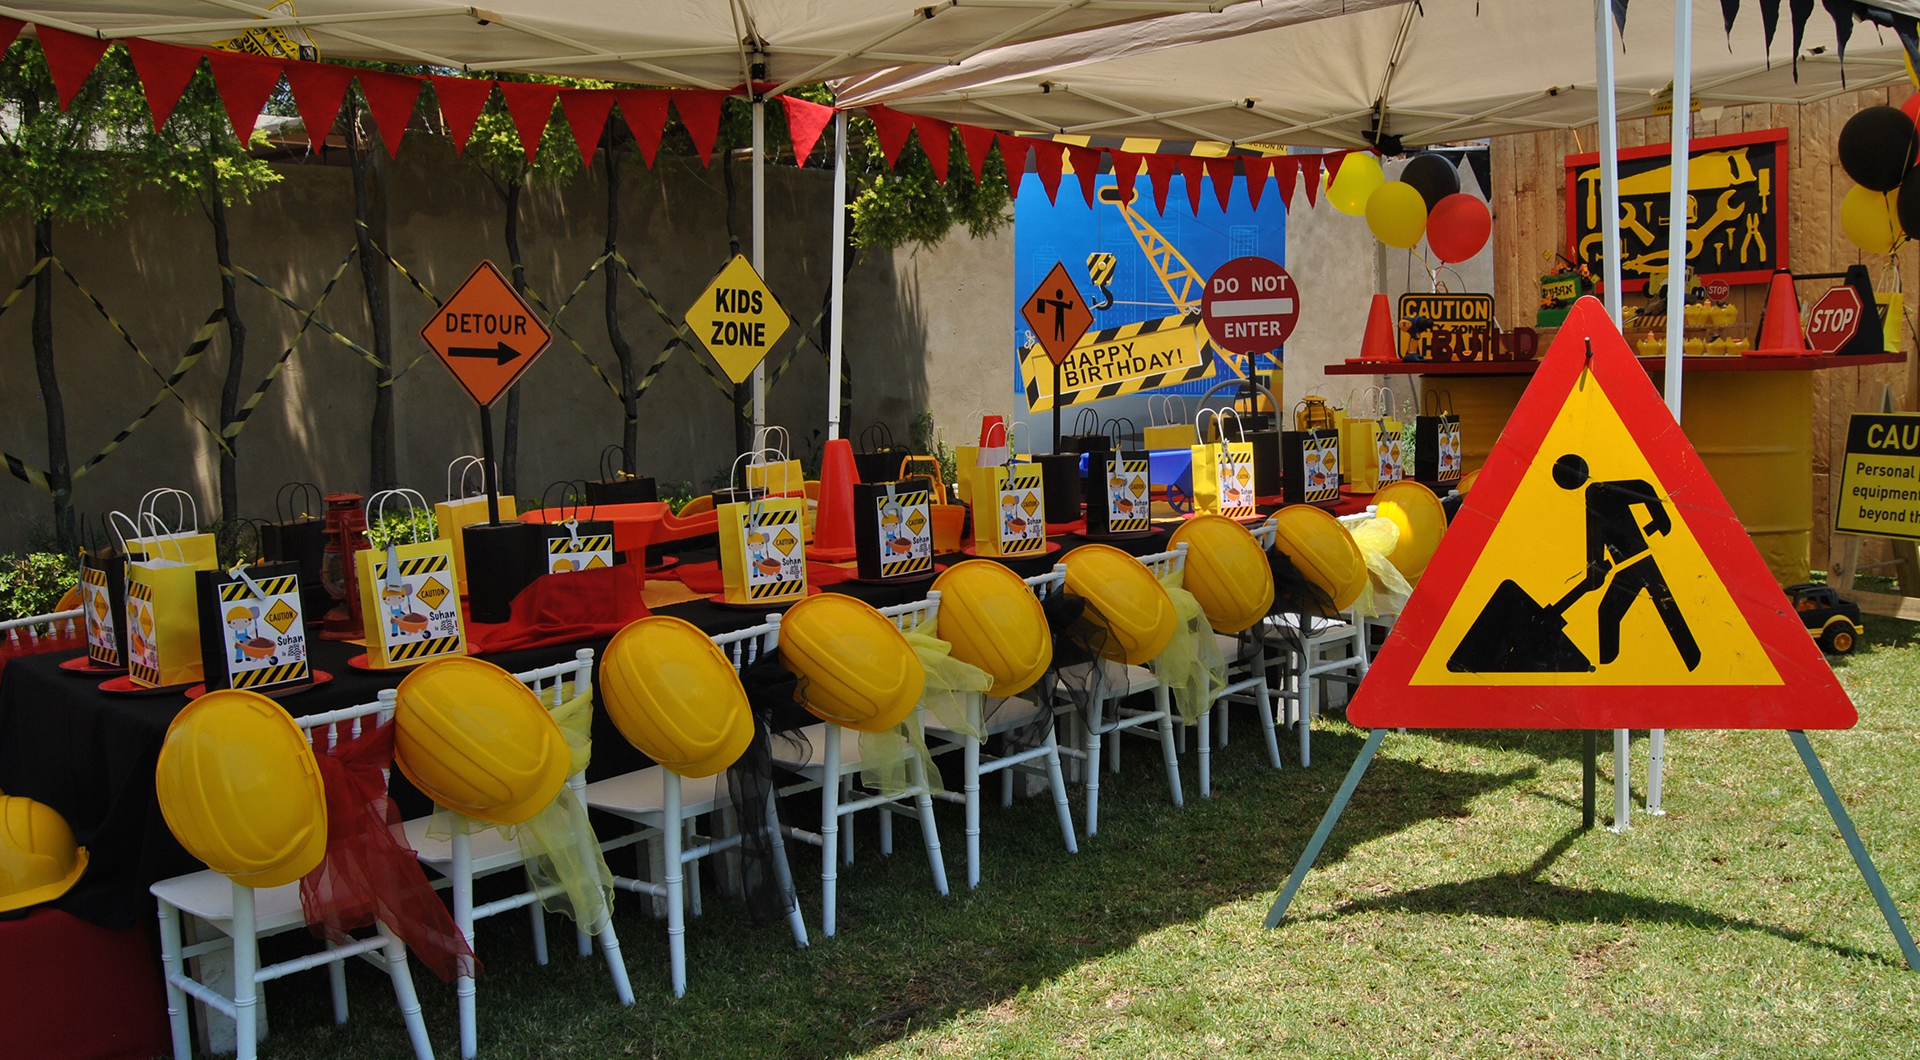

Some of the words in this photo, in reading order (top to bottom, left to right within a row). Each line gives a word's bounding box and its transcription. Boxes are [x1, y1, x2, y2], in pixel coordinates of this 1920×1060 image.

[1213, 277, 1240, 294] DO
[1251, 275, 1289, 292] NOT
[1708, 285, 1728, 295] STOP
[715, 287, 763, 315] KIDS
[1405, 300, 1488, 319] CAUTION
[446, 312, 527, 335] DETOUR
[1224, 321, 1282, 338] ENTER
[1811, 308, 1854, 333] STOP
[711, 320, 766, 347] ZONE
[1432, 327, 1539, 361] BUILD
[1063, 341, 1135, 372] HAPPY
[1064, 348, 1183, 388] BIRTHDAY!
[1856, 462, 1915, 479] Personal
[1859, 505, 1906, 523] beyond
[781, 556, 802, 566] Suhan
[421, 588, 445, 599] CAUTION
[268, 611, 294, 622] CAUTION
[429, 609, 456, 621] Suhan
[277, 634, 304, 646] Suhan
